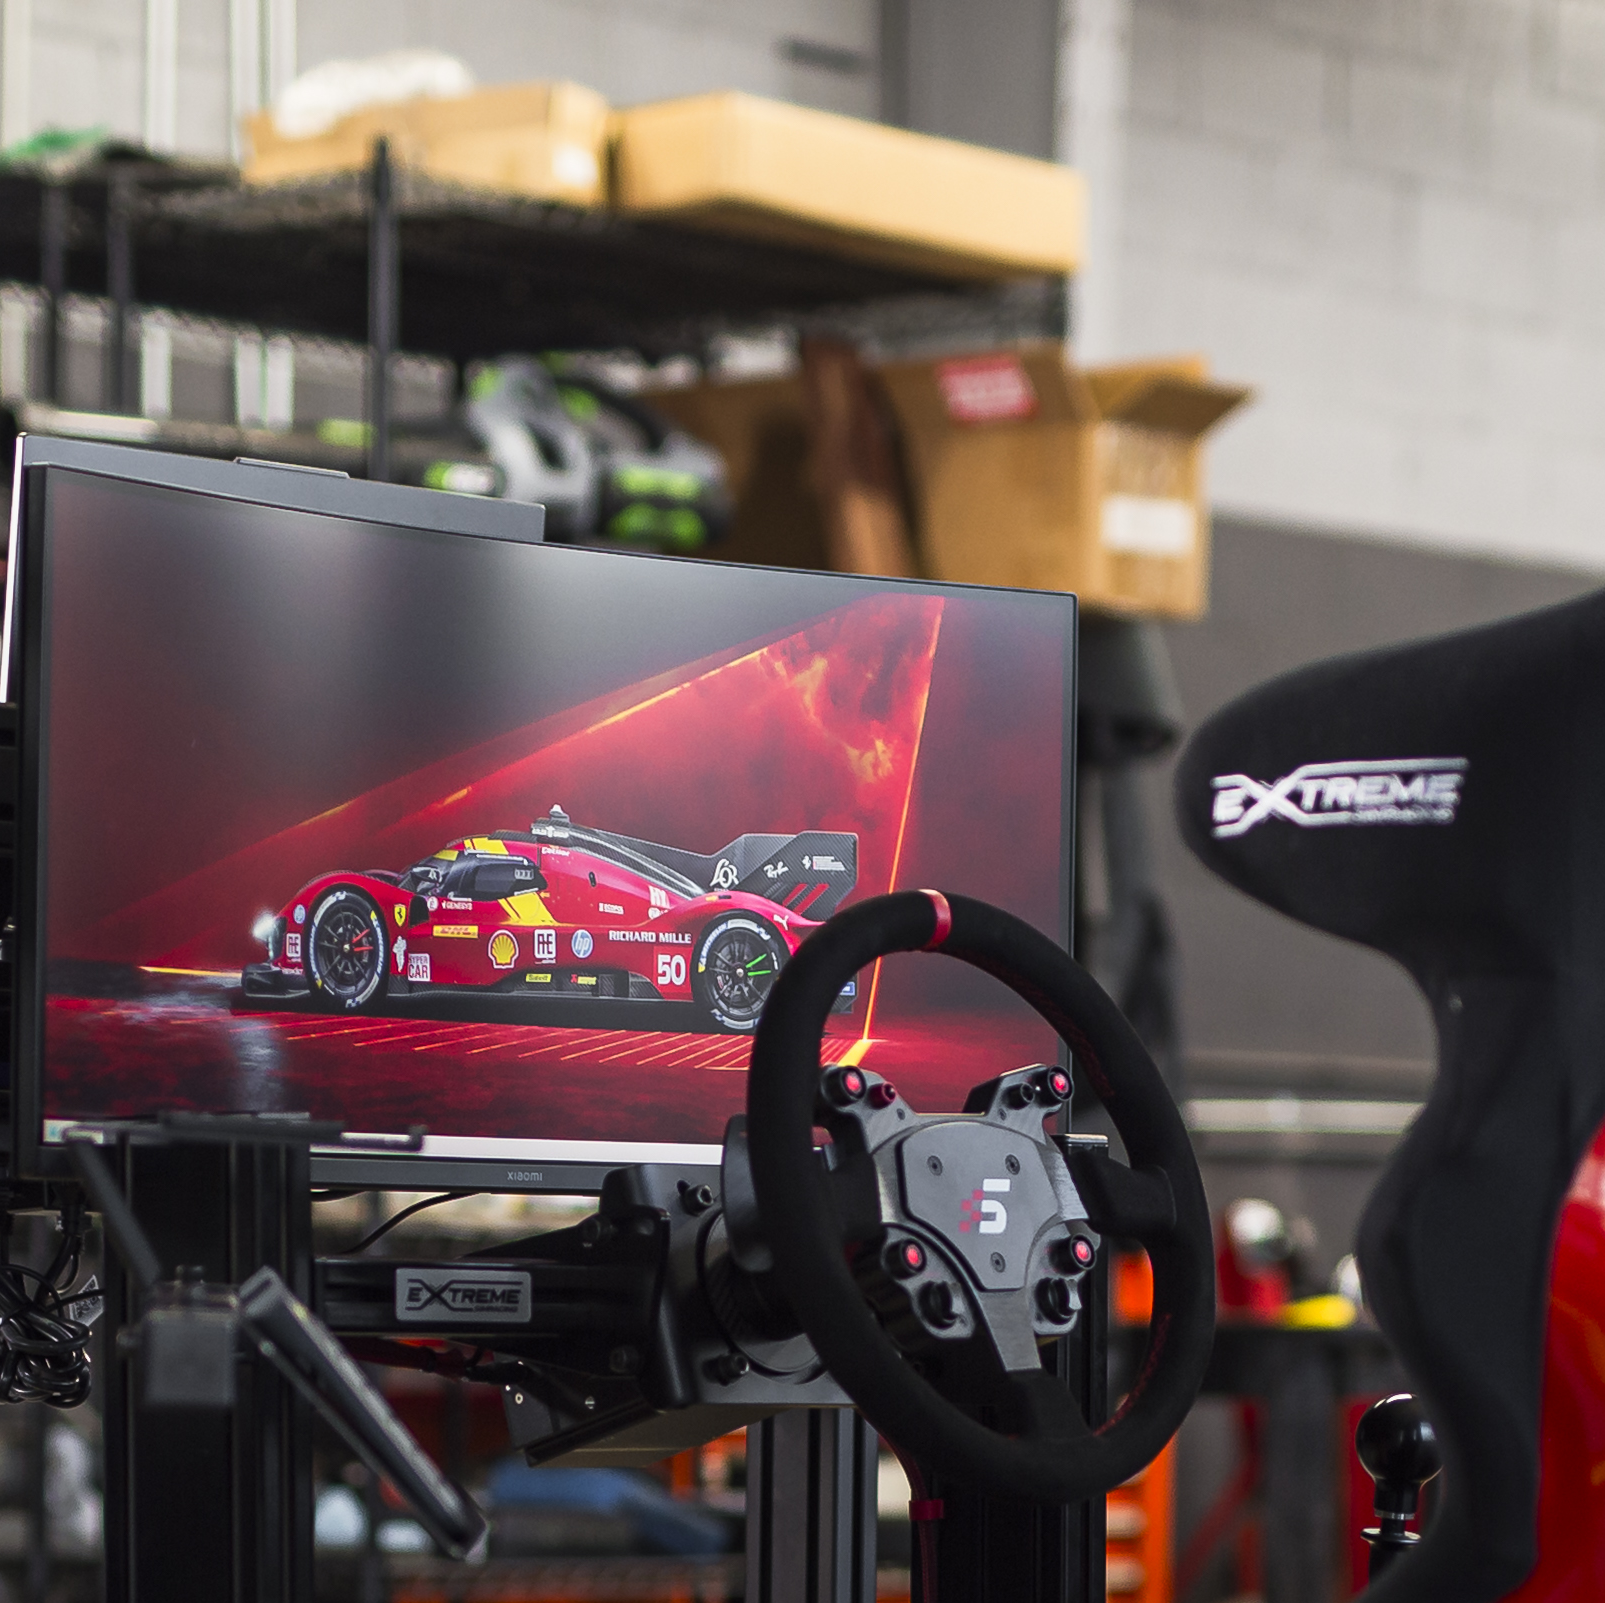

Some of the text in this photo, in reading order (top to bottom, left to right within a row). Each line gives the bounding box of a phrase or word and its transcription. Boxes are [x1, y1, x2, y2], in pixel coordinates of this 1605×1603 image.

[1210, 757, 1468, 839] EXTREME
[576, 935, 591, 952] hp
[609, 930, 692, 944] RICHARD MILLE
[408, 966, 429, 979] CAR
[657, 954, 686, 986] 50
[405, 1278, 523, 1312] EXTREME
